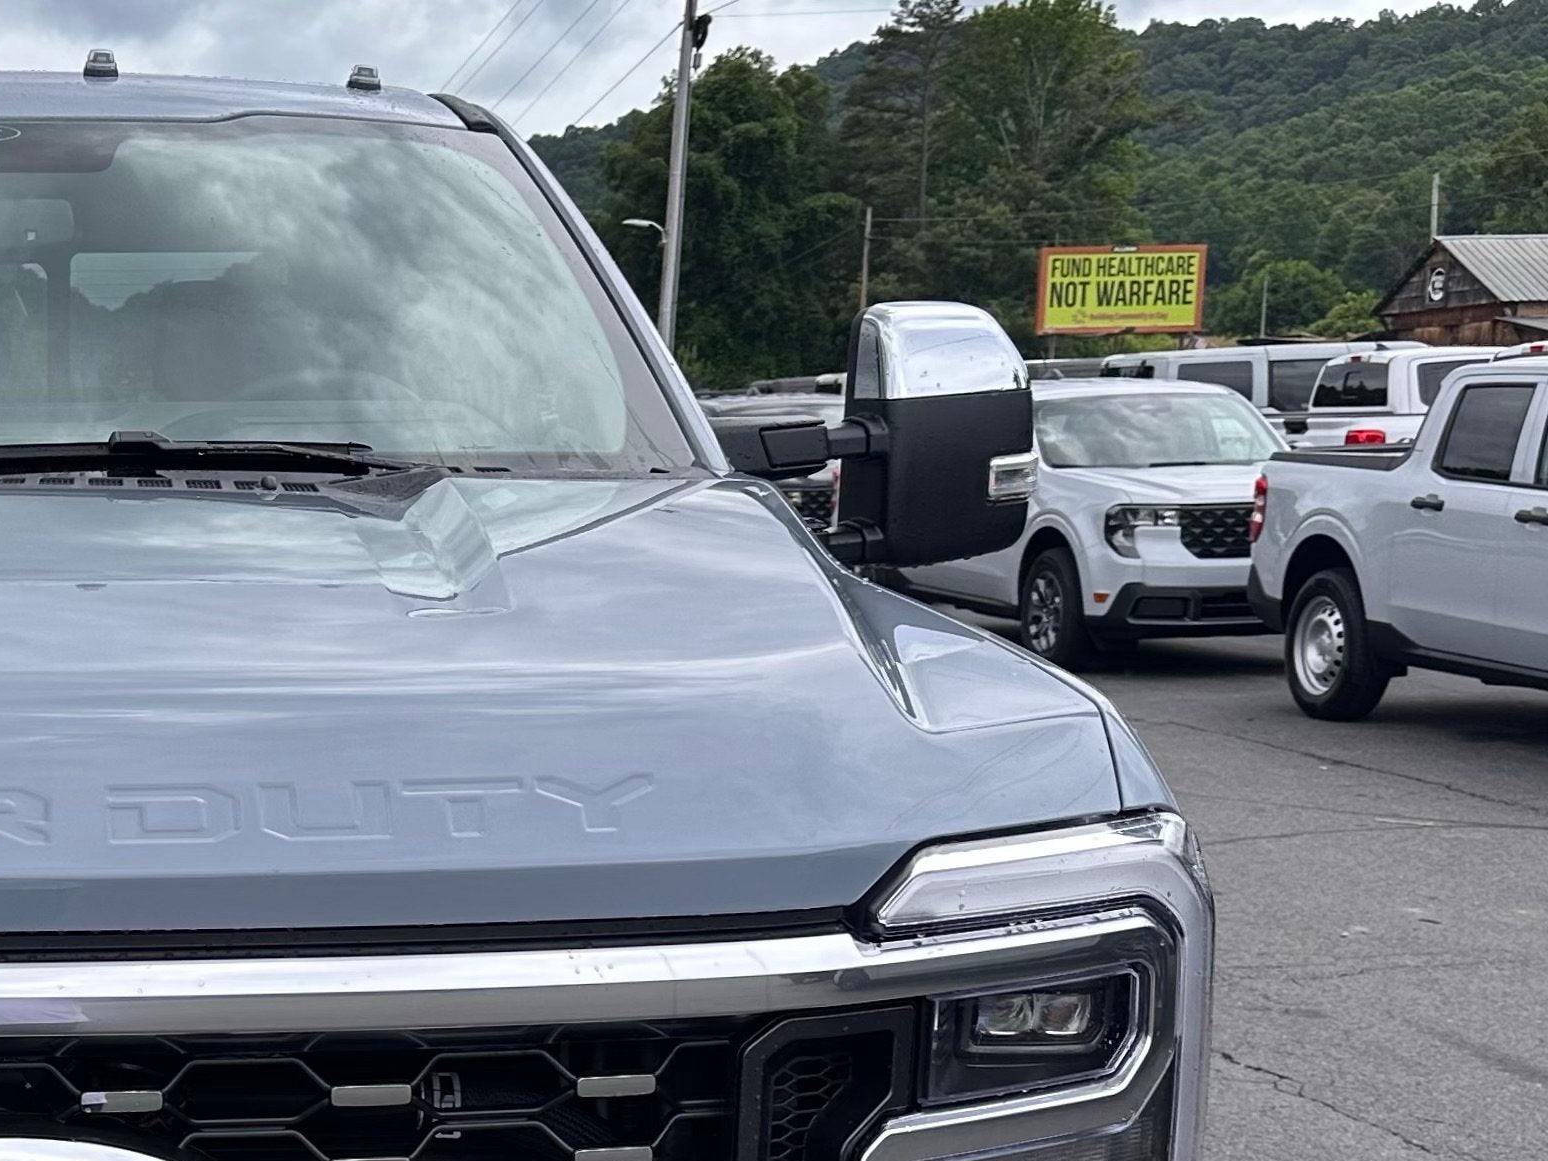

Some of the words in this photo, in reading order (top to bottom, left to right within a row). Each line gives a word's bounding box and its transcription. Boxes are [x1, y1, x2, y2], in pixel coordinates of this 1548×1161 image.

[1051, 257, 1092, 278] FUND
[1095, 255, 1197, 277] HEALTHCARE
[1049, 281, 1091, 308] NOT
[1096, 279, 1194, 307] WARFARE
[104, 772, 654, 845] DUTY
